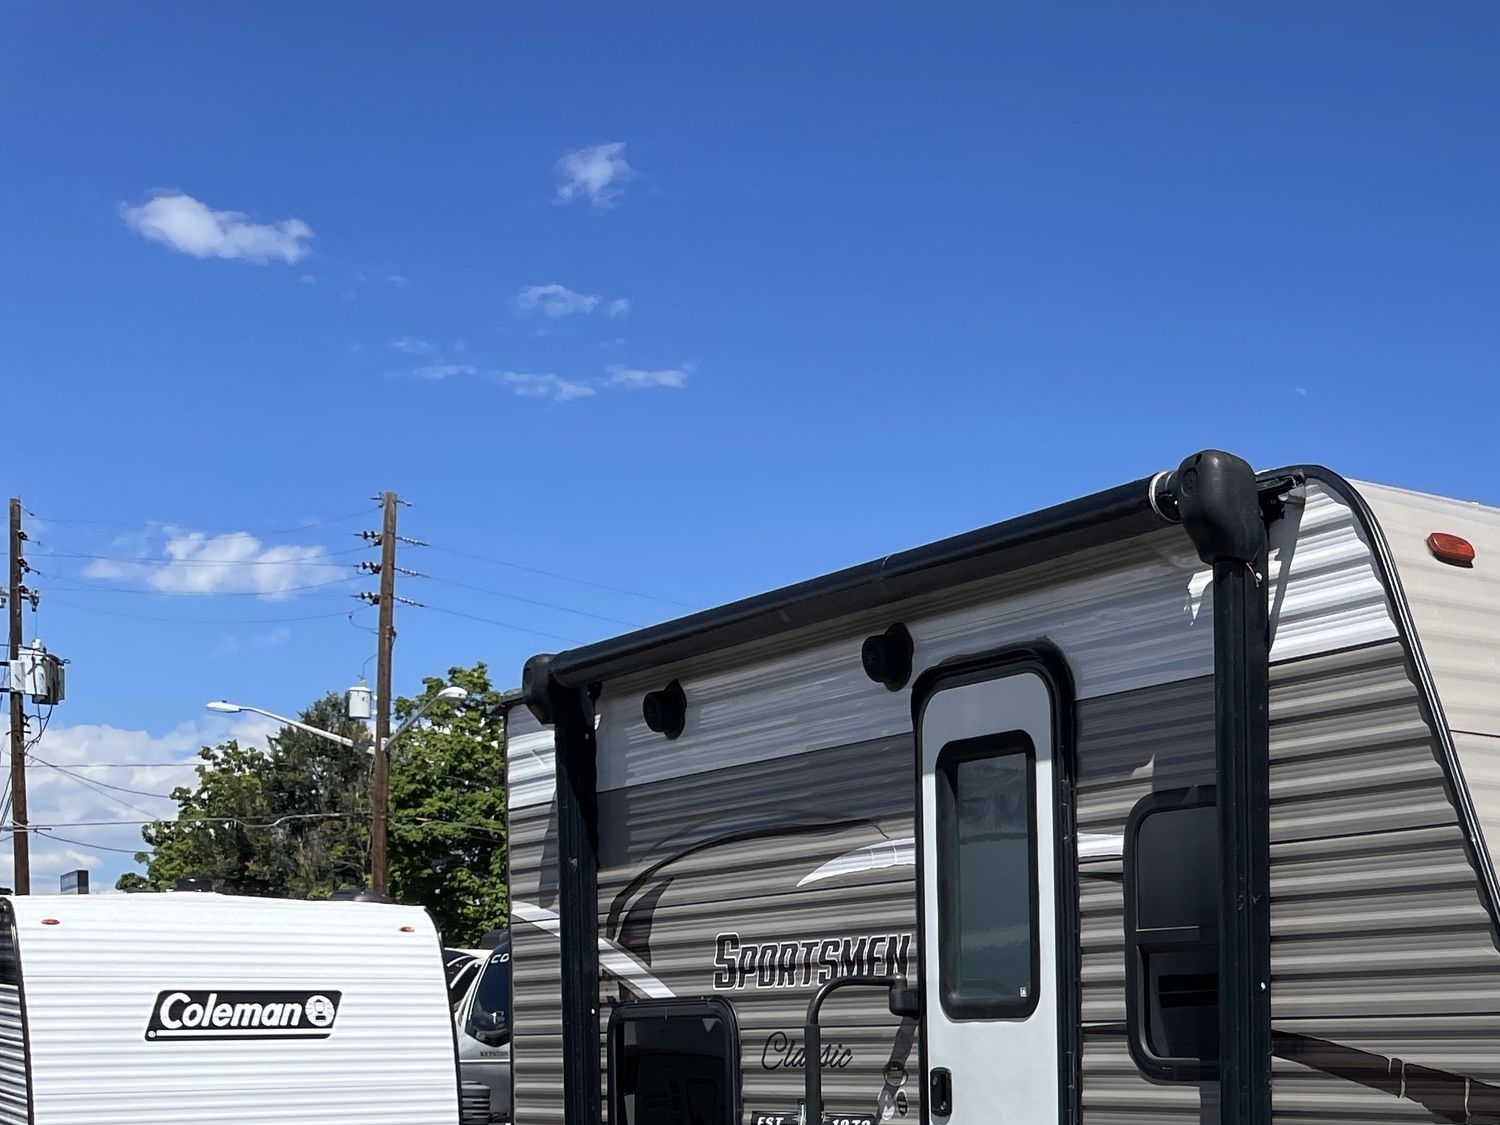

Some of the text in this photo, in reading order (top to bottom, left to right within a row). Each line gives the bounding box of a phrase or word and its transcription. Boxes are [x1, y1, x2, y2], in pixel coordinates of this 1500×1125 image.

[713, 932, 912, 990] SPORTSMEN
[159, 992, 302, 1029] Coleman
[761, 1031, 853, 1070] Clasic
